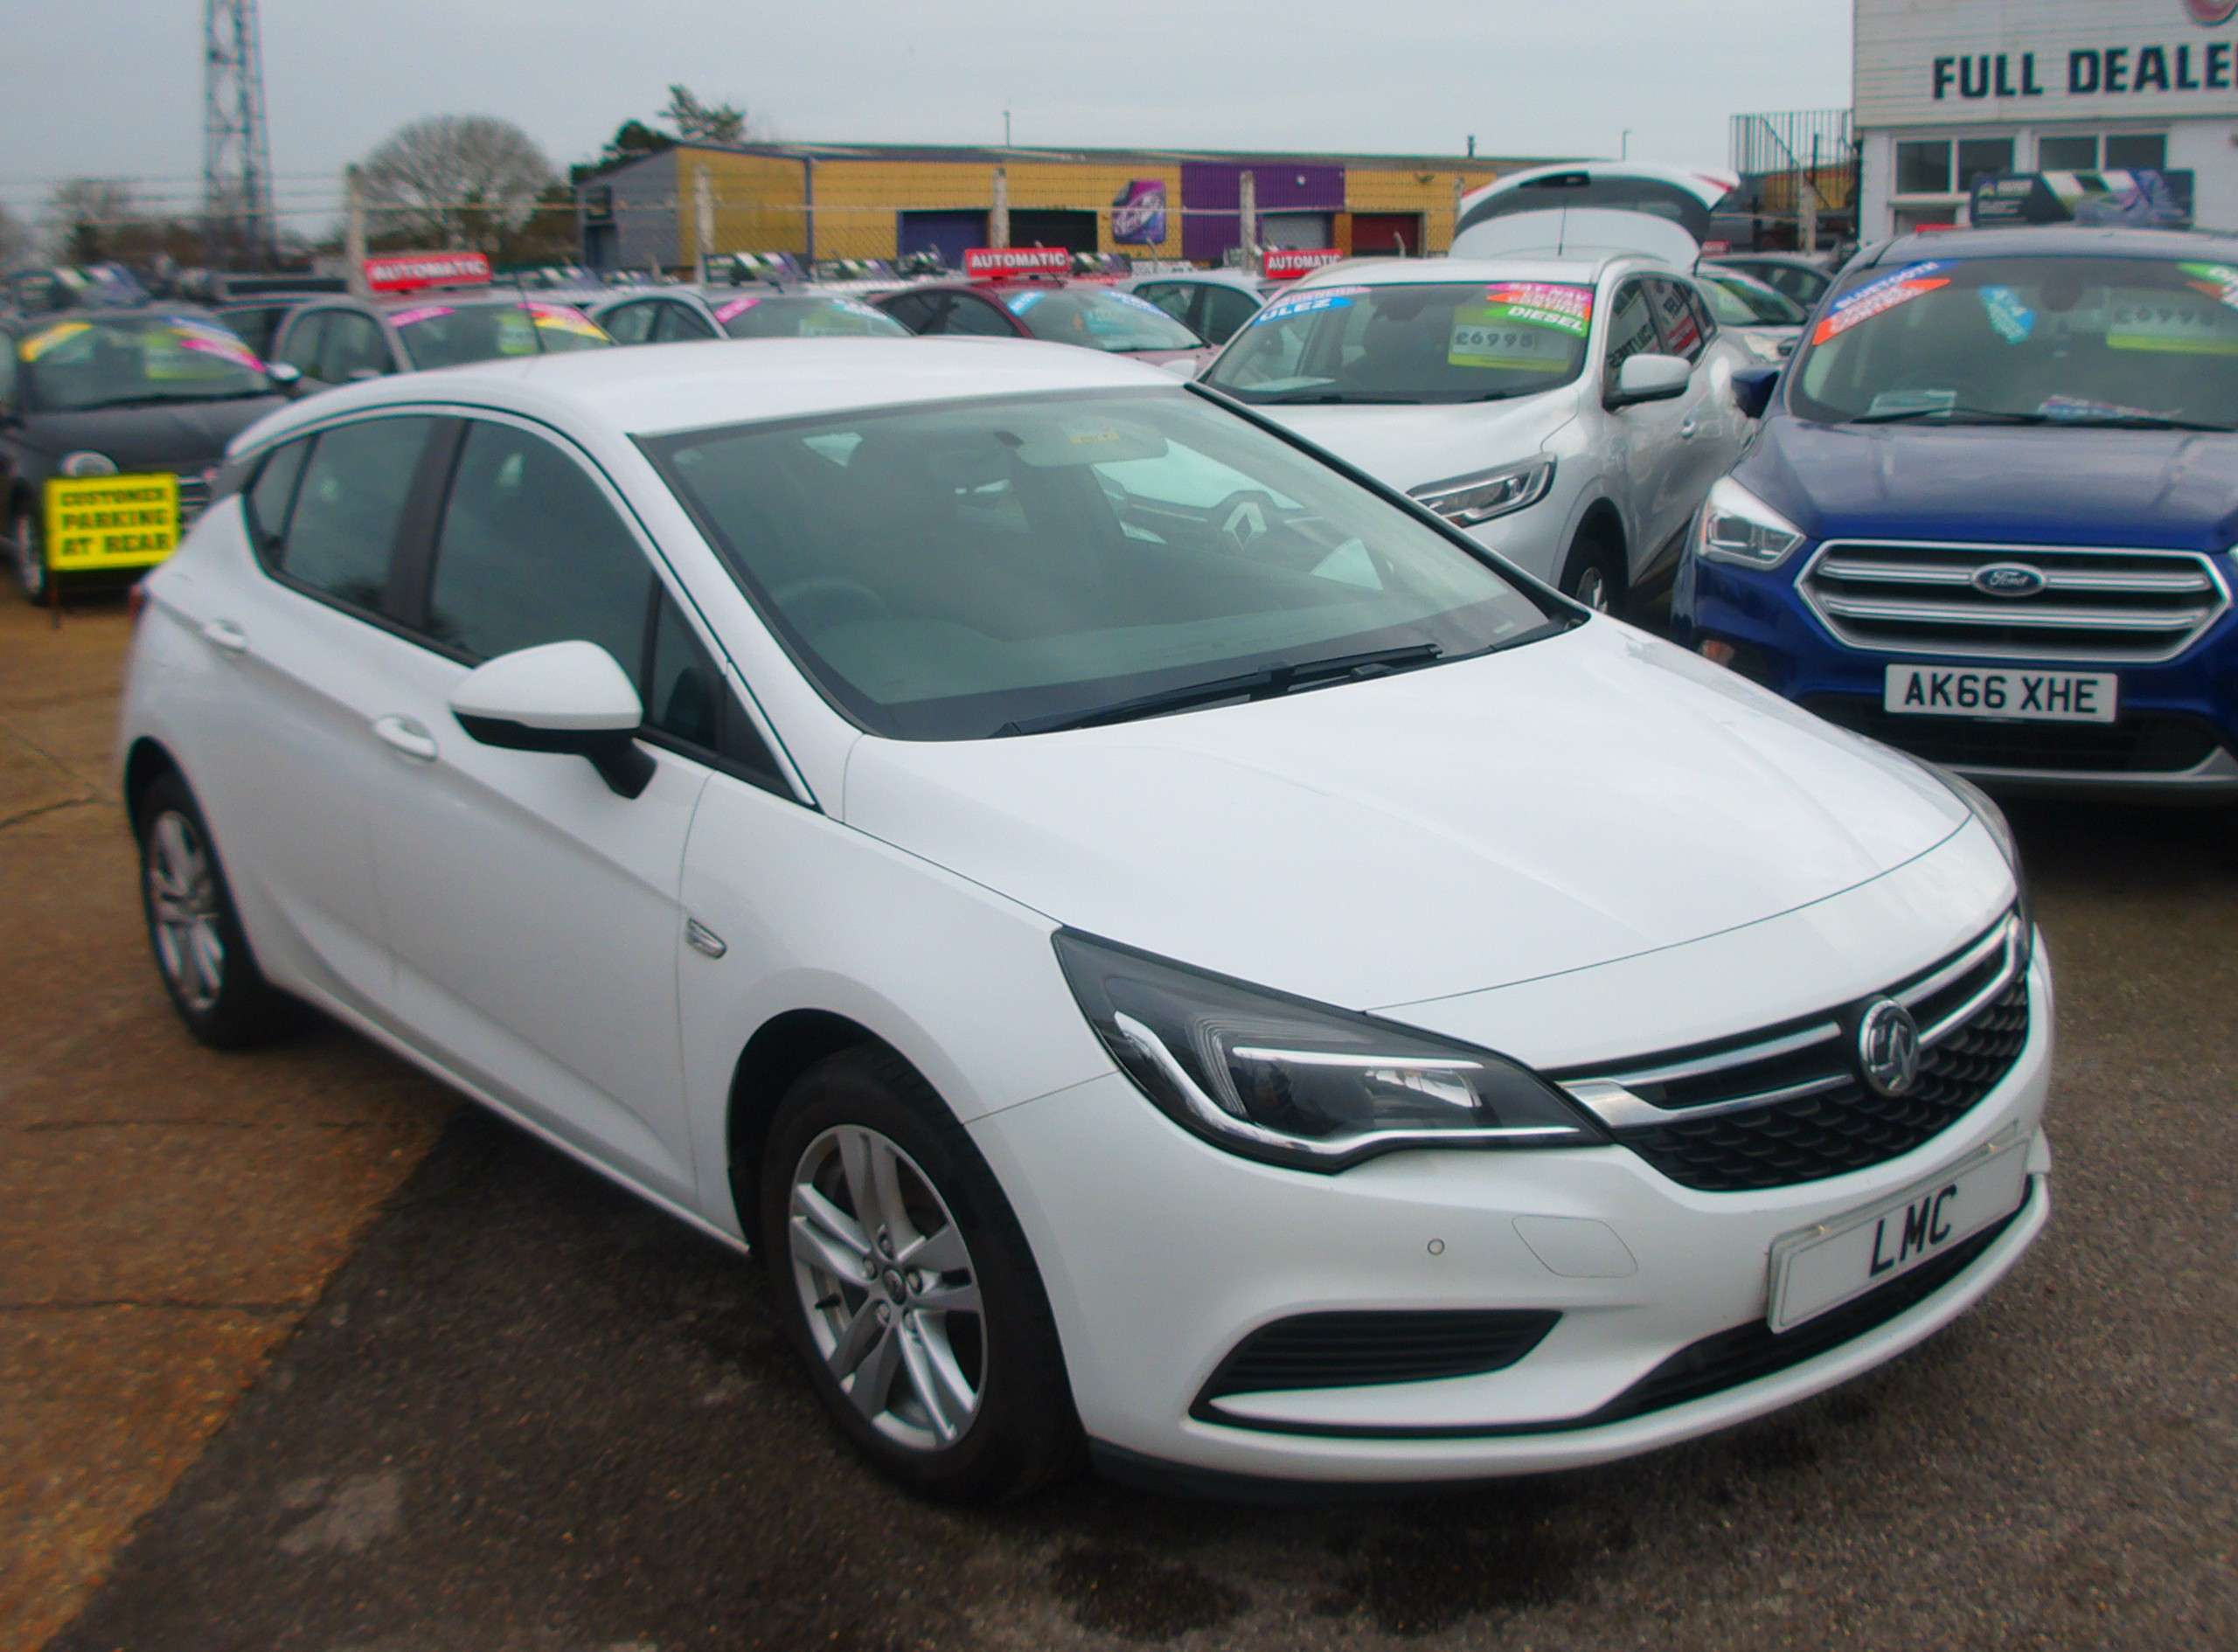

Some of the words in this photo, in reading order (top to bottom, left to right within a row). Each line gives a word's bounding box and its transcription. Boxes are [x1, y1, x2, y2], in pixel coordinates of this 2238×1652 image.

[1933, 52, 2044, 100] FULL
[2068, 42, 2238, 94] DEALE
[372, 260, 489, 281] AUTOMATIC
[971, 251, 1067, 268] AUTOMATIC
[1260, 297, 1332, 322] ULEZ
[1508, 305, 1583, 331] DIESEL
[60, 489, 166, 507] CUSTOMER
[60, 509, 169, 531] PARKING
[61, 537, 94, 557] AT
[103, 533, 170, 554] REAR
[1990, 571, 2029, 587] Ford
[1904, 671, 2008, 710] AK66
[2020, 676, 2099, 714] XHE
[1870, 1183, 1958, 1278] LMC
